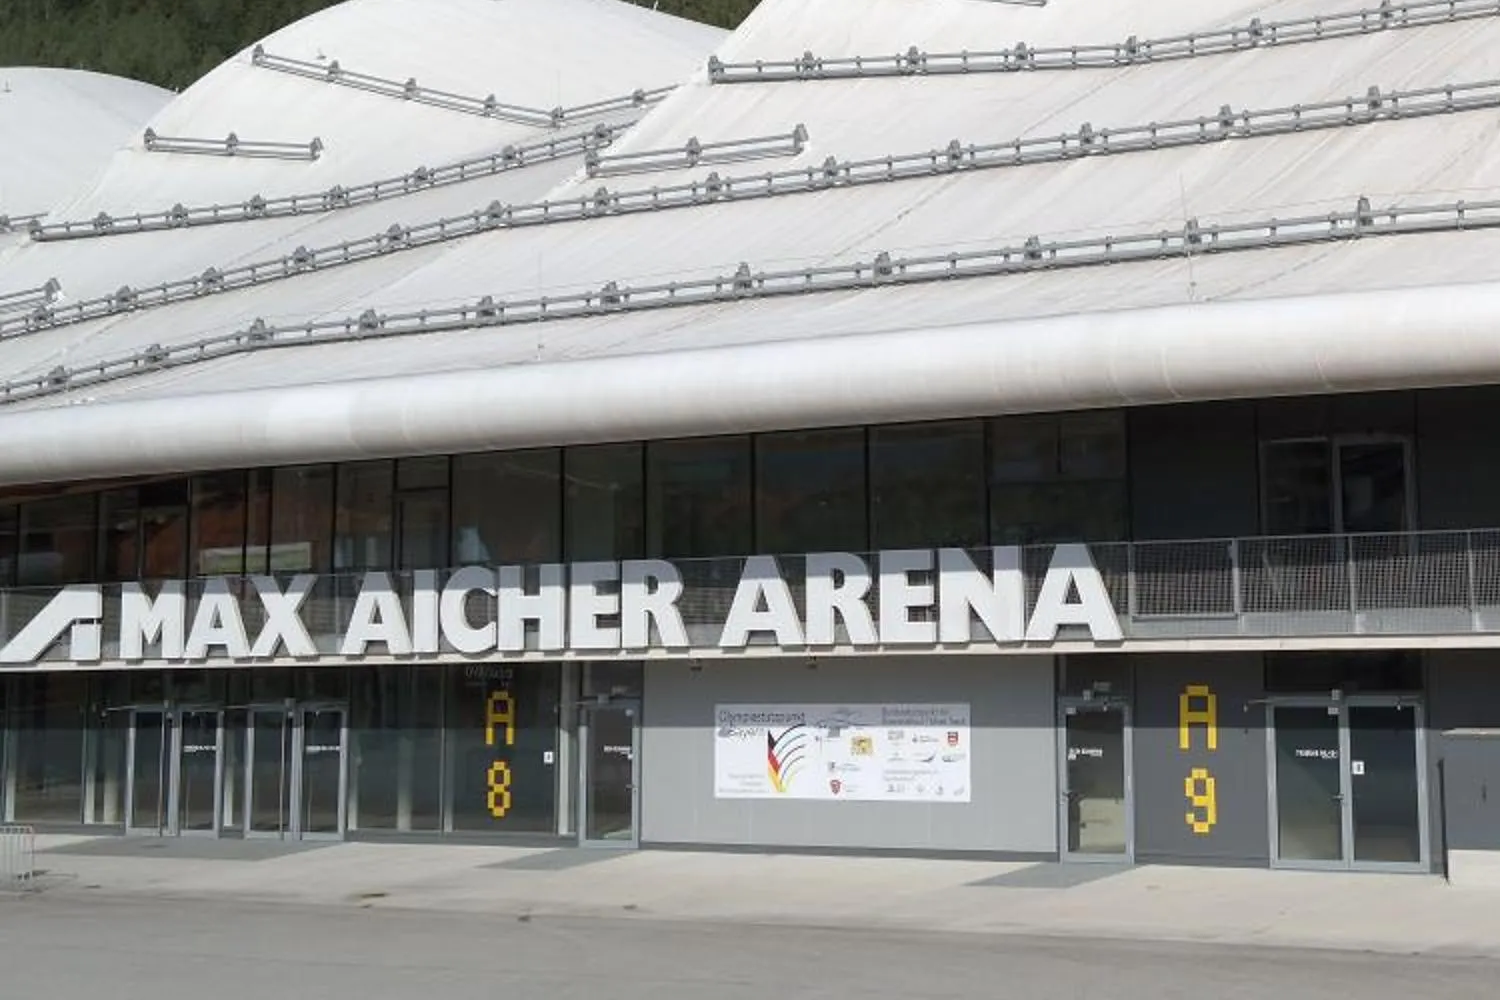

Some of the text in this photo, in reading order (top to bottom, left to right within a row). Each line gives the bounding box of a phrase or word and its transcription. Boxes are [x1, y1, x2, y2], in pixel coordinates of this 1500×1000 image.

[119, 573, 318, 660] MAX
[339, 558, 692, 656] AICHER
[718, 542, 1126, 646] ARENA
